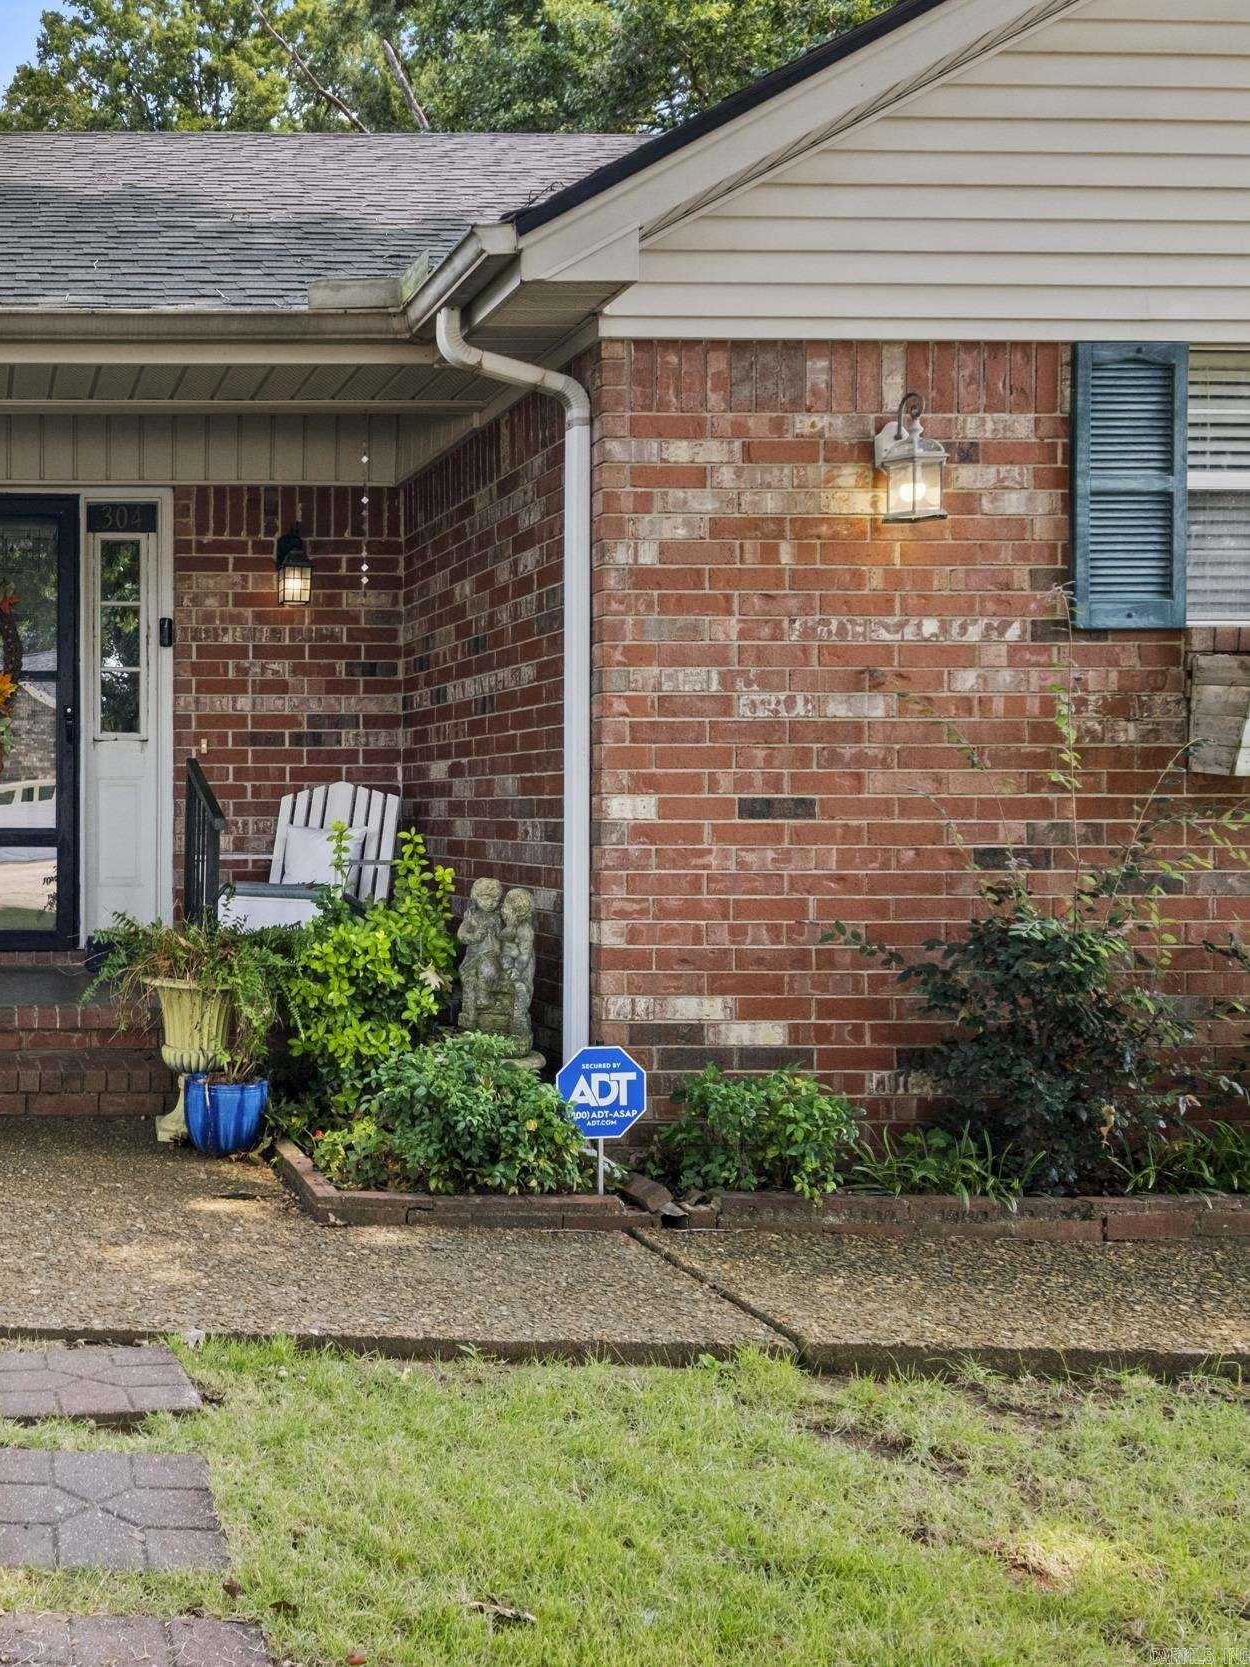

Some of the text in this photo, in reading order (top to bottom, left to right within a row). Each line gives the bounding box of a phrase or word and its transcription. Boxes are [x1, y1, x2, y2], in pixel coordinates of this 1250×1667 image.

[581, 1062, 611, 1070] SECURED
[568, 1072, 637, 1107] ADT
[590, 1109, 638, 1119] ADT-ASAP
[586, 1119, 617, 1127] ADT.COM
